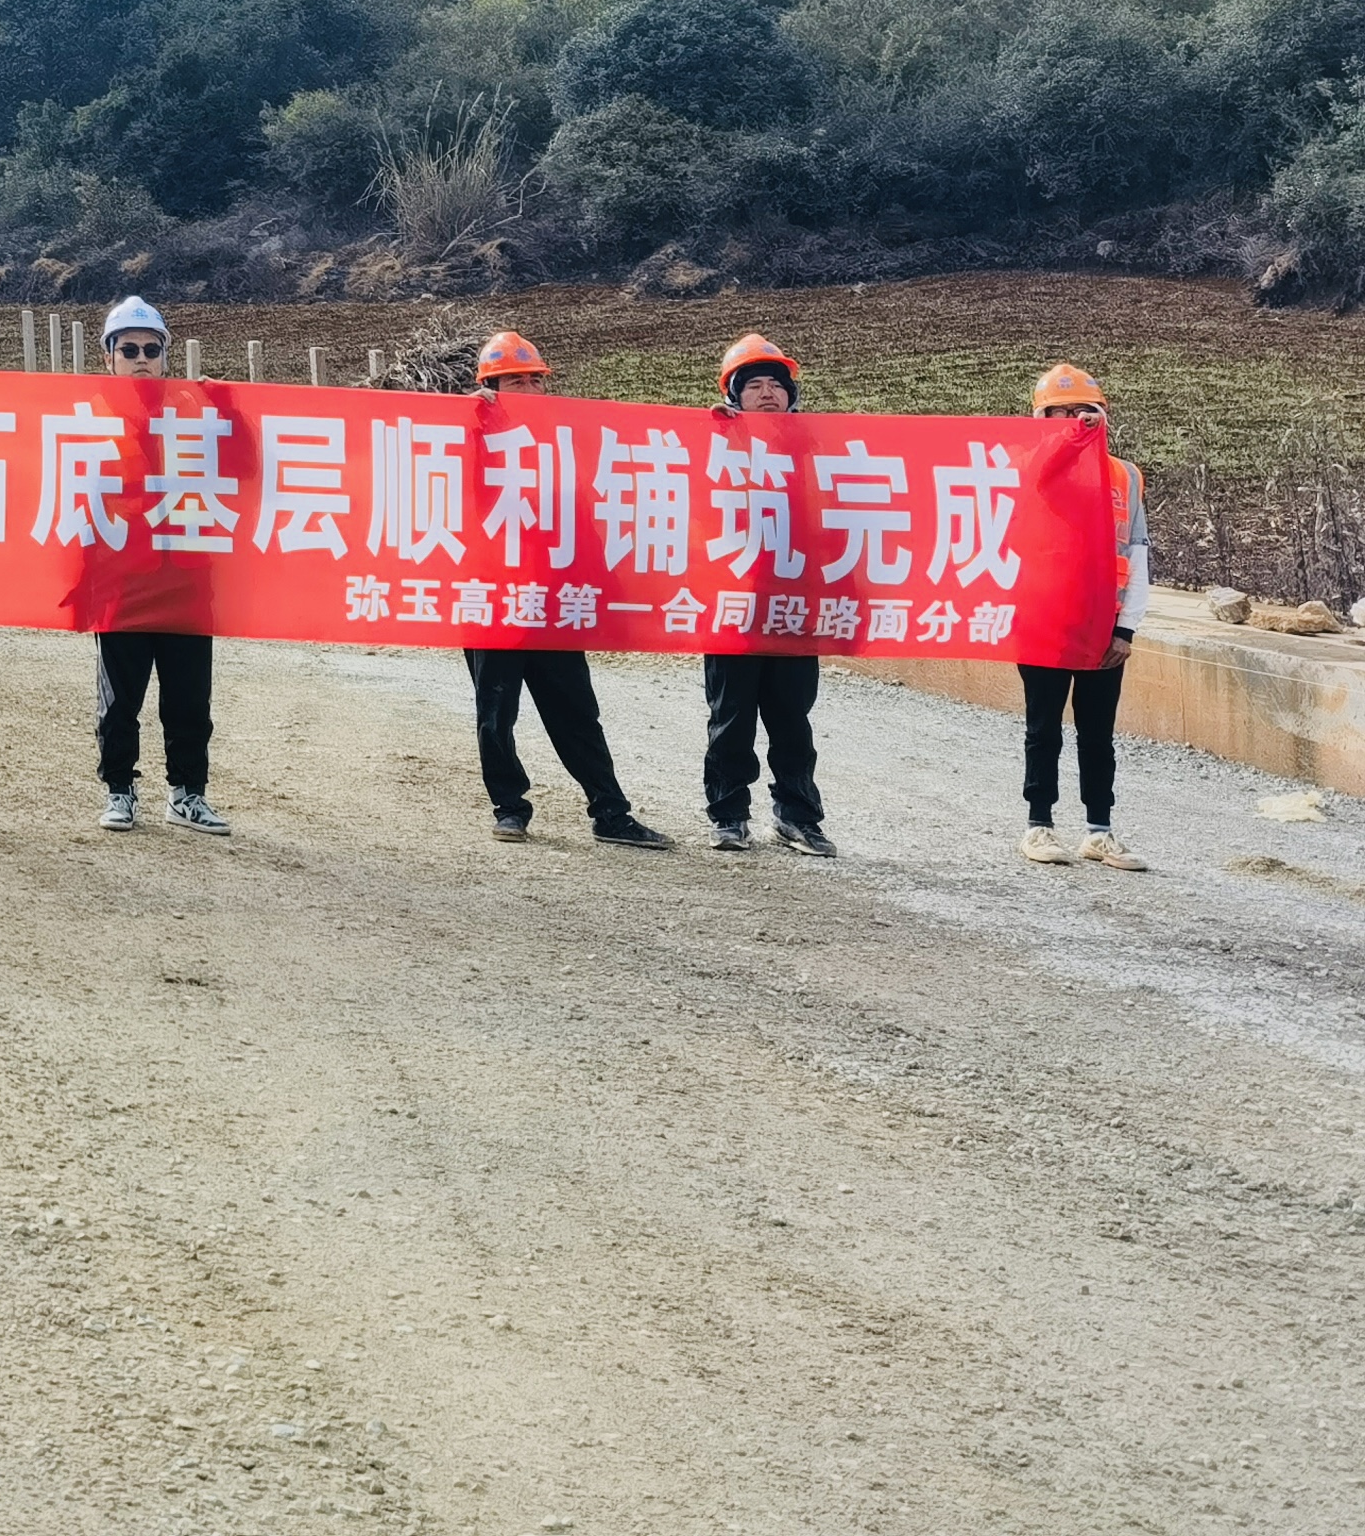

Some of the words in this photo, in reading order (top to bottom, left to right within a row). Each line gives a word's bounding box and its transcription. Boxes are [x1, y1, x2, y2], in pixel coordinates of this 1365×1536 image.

[346, 575, 1016, 645] 弥玉高速第一合同段路面分部
